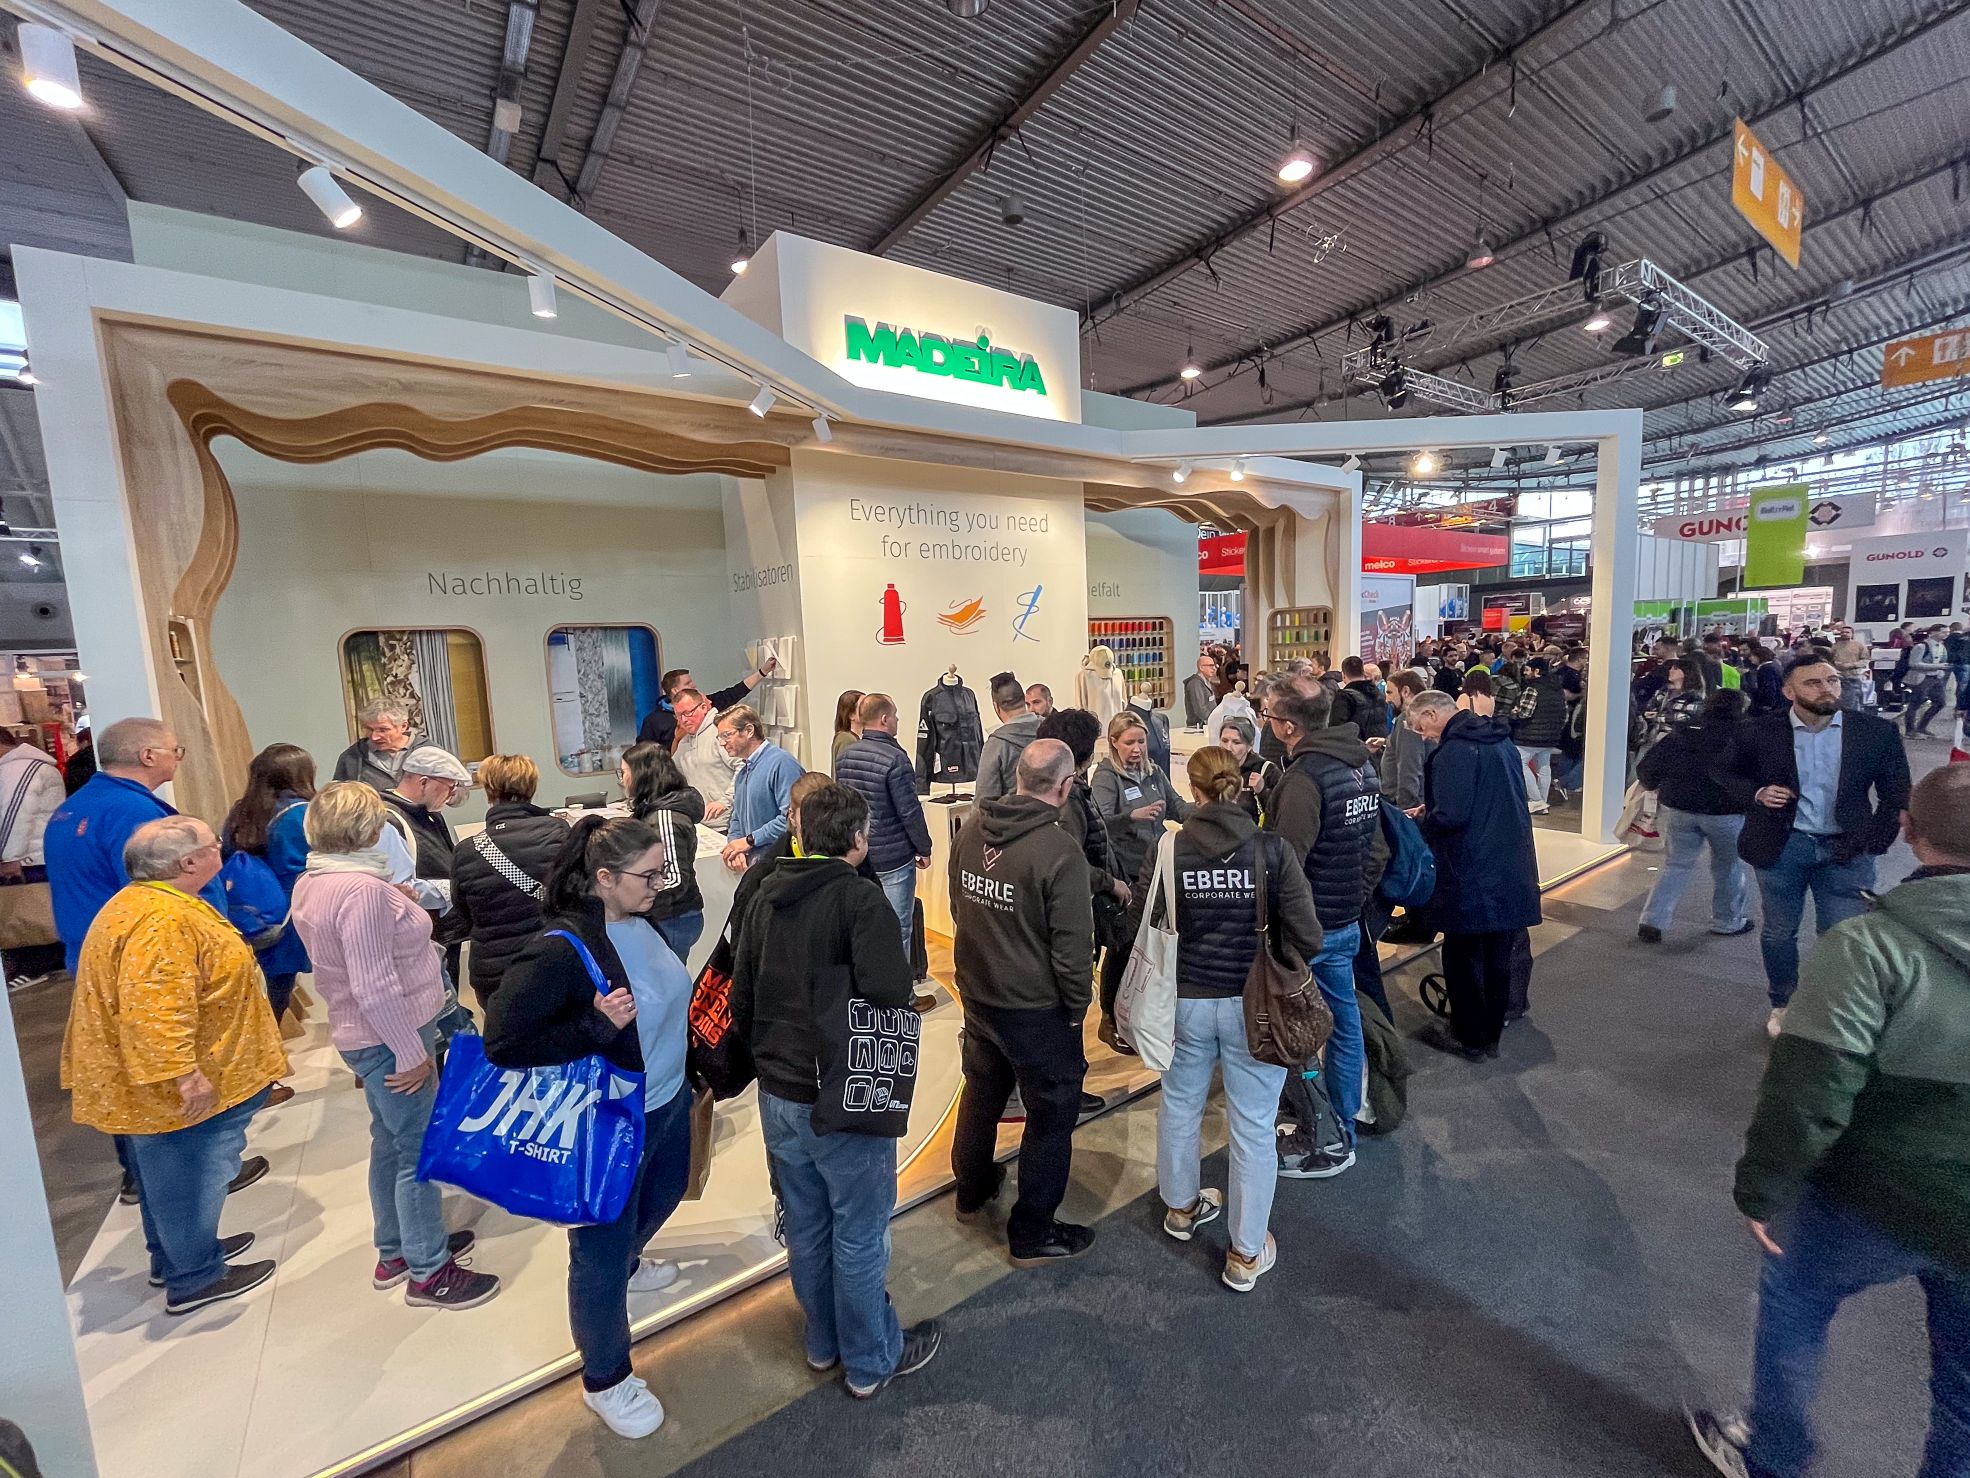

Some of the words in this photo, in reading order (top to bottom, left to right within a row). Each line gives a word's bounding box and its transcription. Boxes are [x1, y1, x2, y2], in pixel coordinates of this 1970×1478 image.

[850, 499, 960, 532] Everything
[965, 512, 999, 533] you
[1007, 514, 1049, 533] need
[881, 535, 911, 558] for
[919, 539, 1028, 567] embroidery
[1866, 550, 1925, 562] GUNOLD
[733, 563, 793, 592] Stabilisatoren
[1364, 559, 1395, 571] melco
[428, 571, 584, 600] Nachhaltig
[1345, 793, 1379, 817] EBERLE
[961, 869, 1015, 903] EBERLE
[1182, 869, 1264, 890] EBERL
[1185, 891, 1241, 899] CORPORATE
[457, 1070, 603, 1149] JHK
[509, 1141, 571, 1165] T-SHIRT
